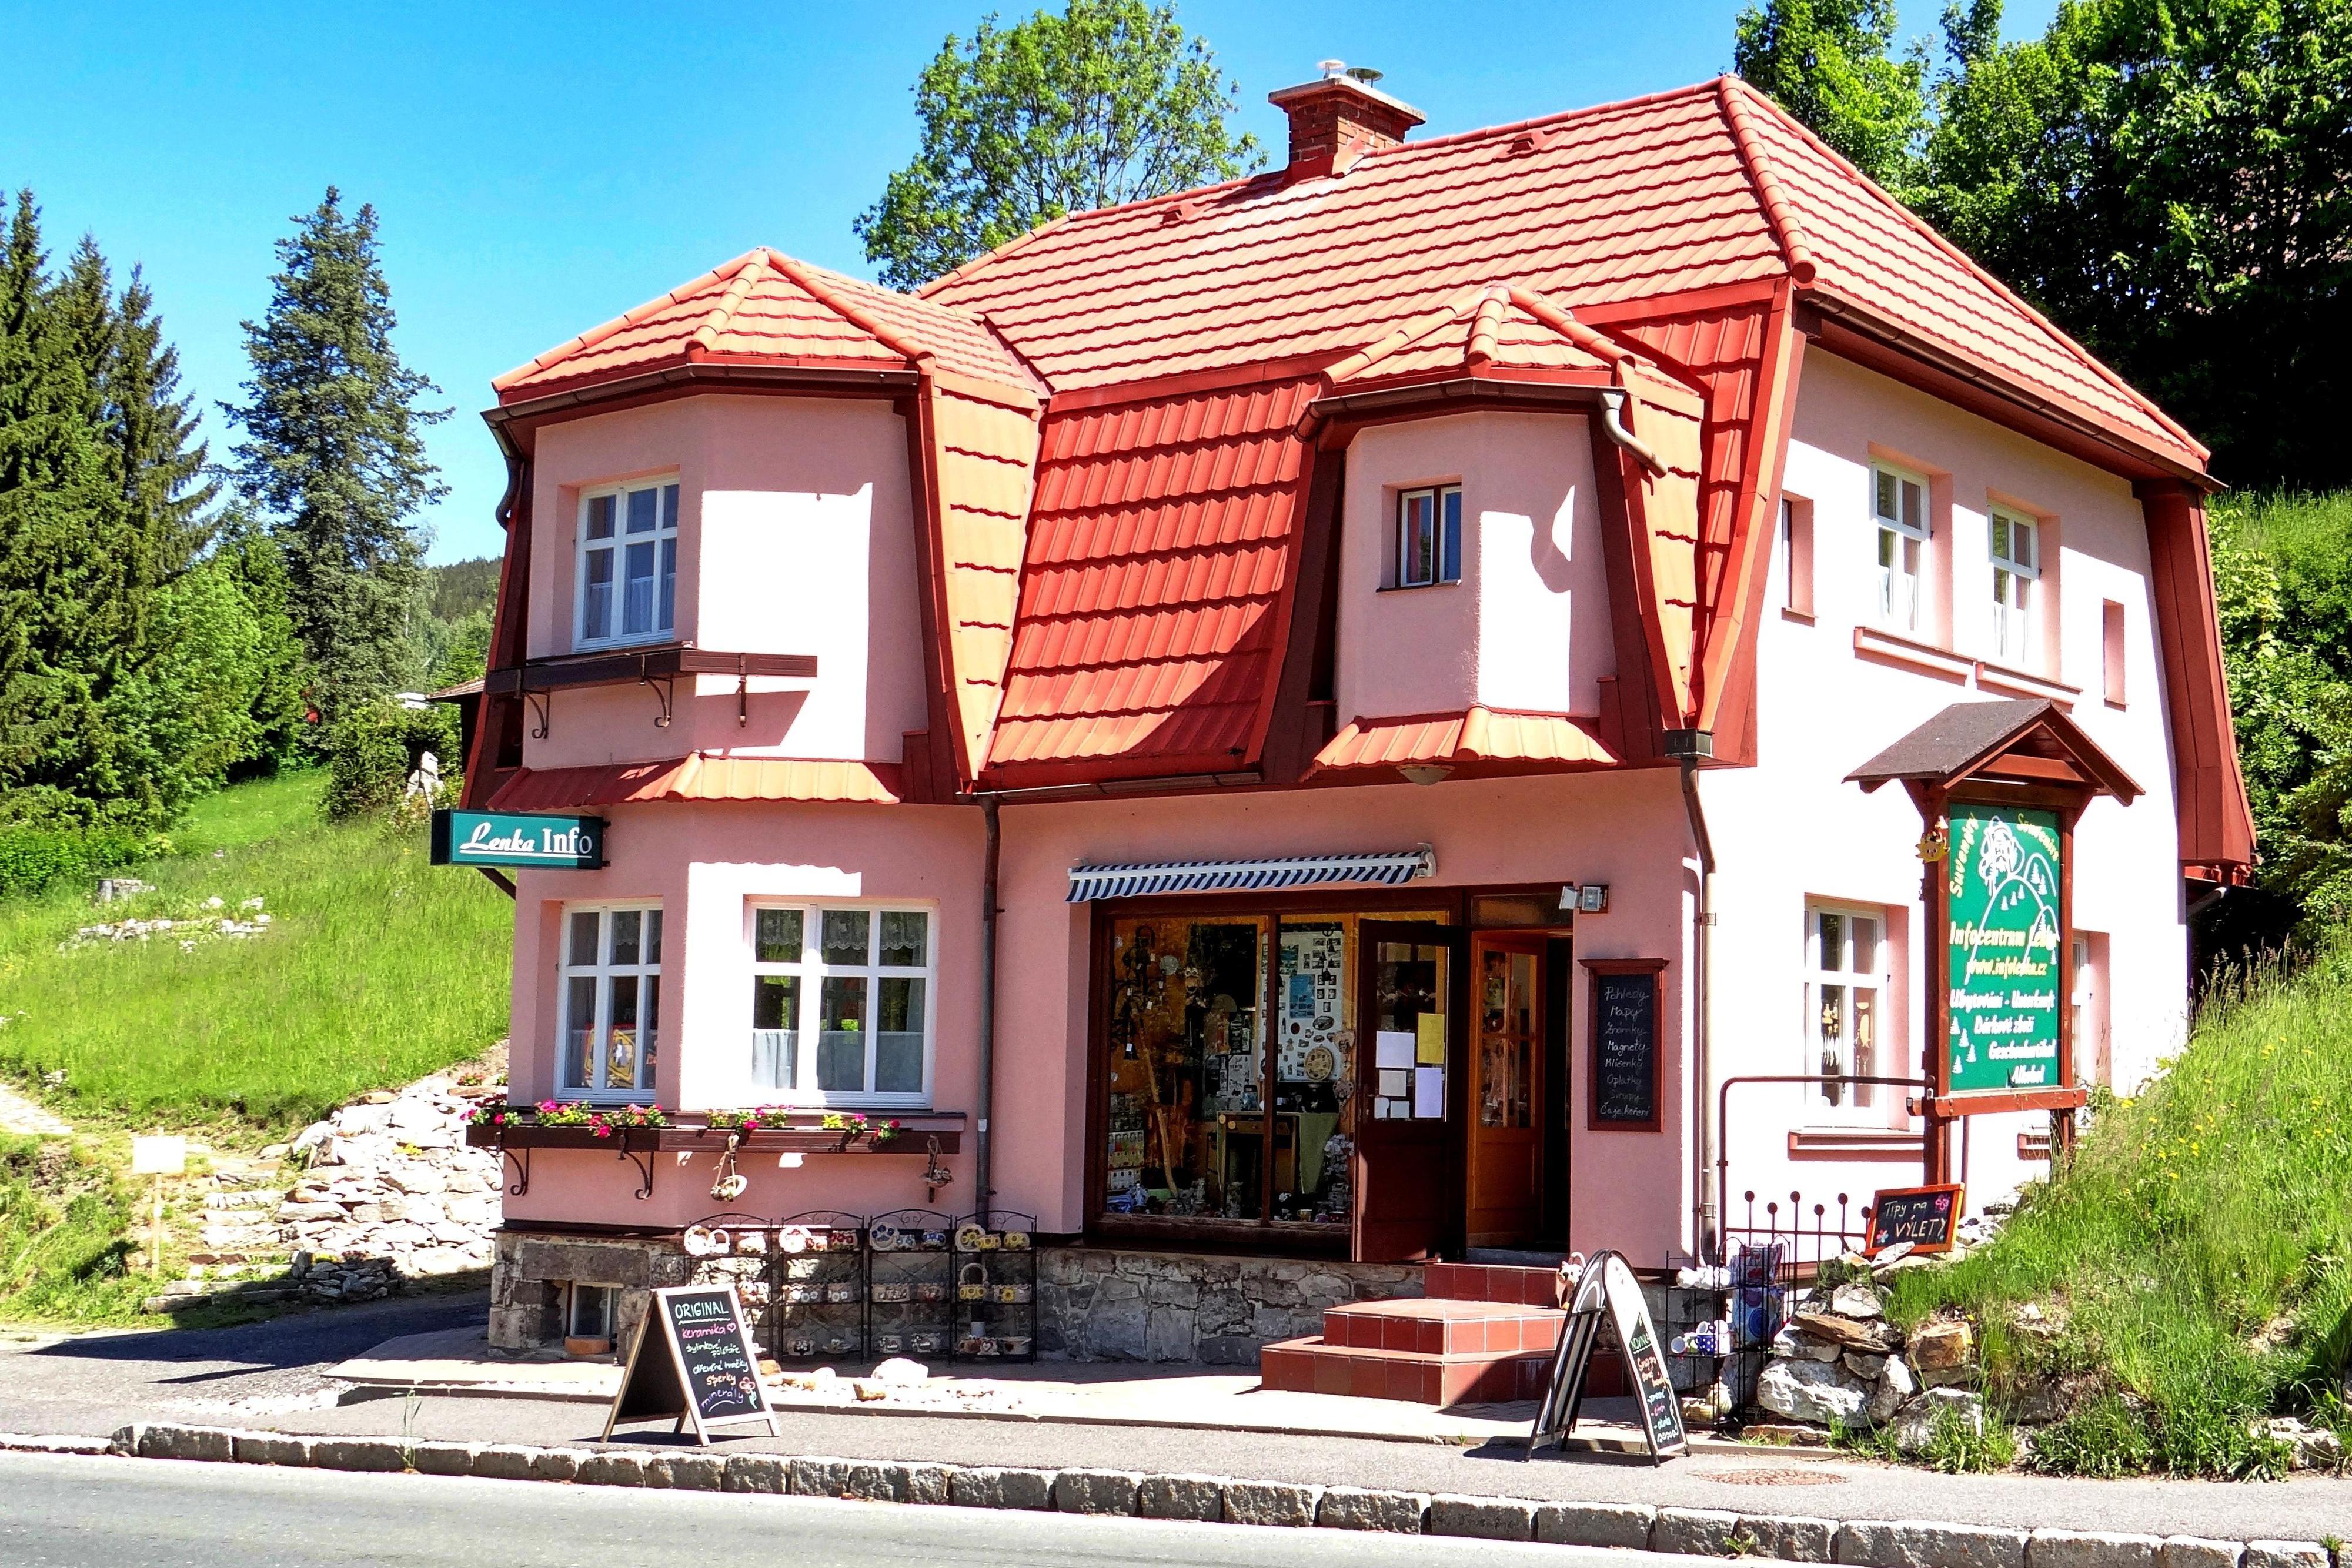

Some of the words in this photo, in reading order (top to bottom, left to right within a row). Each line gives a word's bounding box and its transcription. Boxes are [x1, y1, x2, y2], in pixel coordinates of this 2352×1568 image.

[459, 821, 535, 852] Lenka
[542, 827, 593, 854] Info
[1949, 921, 2026, 951] Infocentrum
[1604, 986, 1649, 1007] Pohledy
[1610, 1005, 1643, 1022] Mapy
[1608, 1039, 1651, 1061] Magnety
[1913, 1201, 1927, 1209] na
[1896, 1214, 1947, 1238] VÝLETY
[674, 1300, 729, 1319] ORIGINAL
